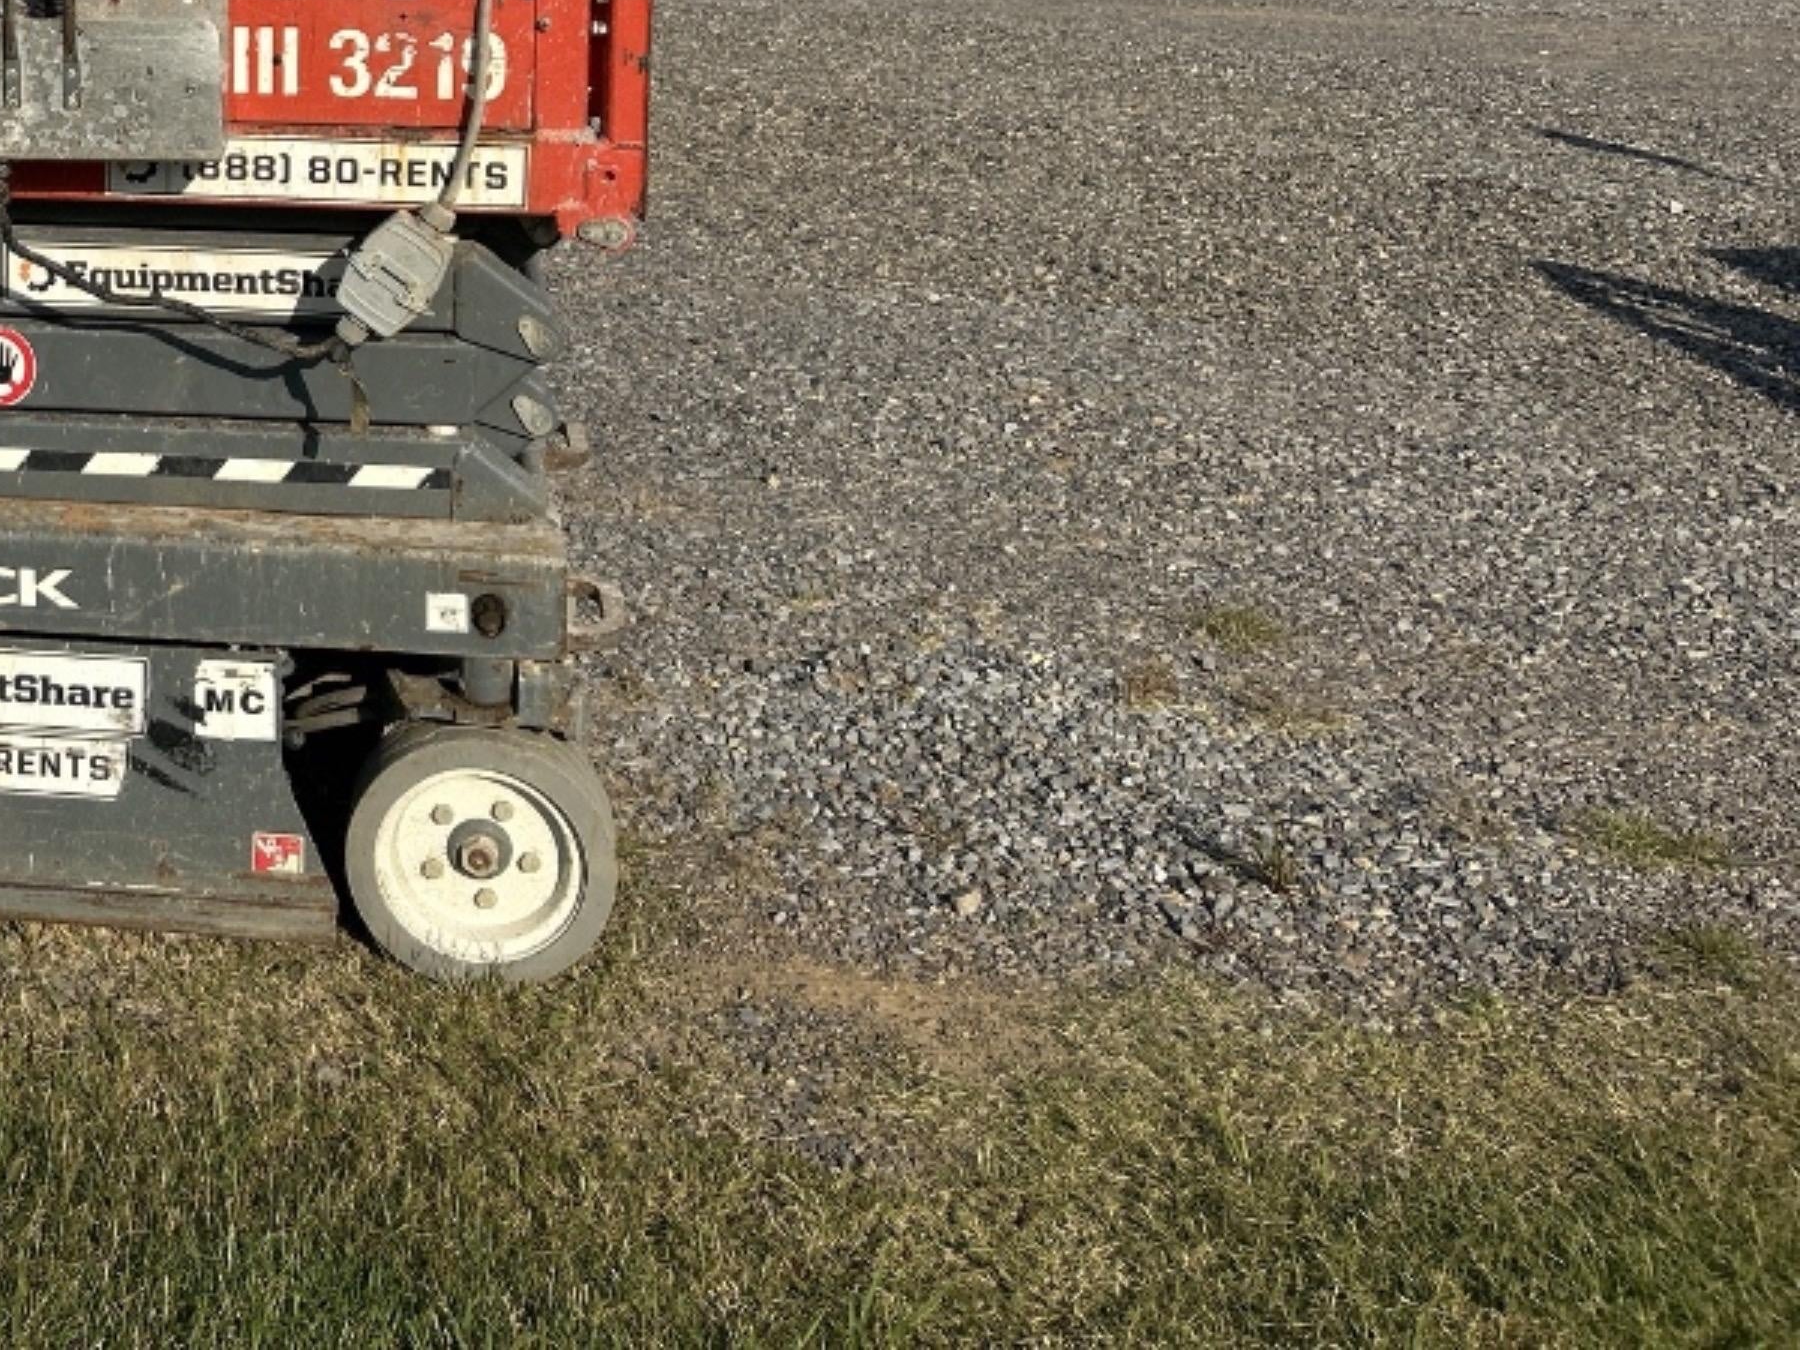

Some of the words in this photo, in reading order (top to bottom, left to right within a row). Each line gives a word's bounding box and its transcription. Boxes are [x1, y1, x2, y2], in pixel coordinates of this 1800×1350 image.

[328, 28, 509, 101] 3219
[308, 155, 509, 190] 80-RENTS
[64, 259, 342, 298] EquipmentSh
[206, 688, 265, 716] MC
